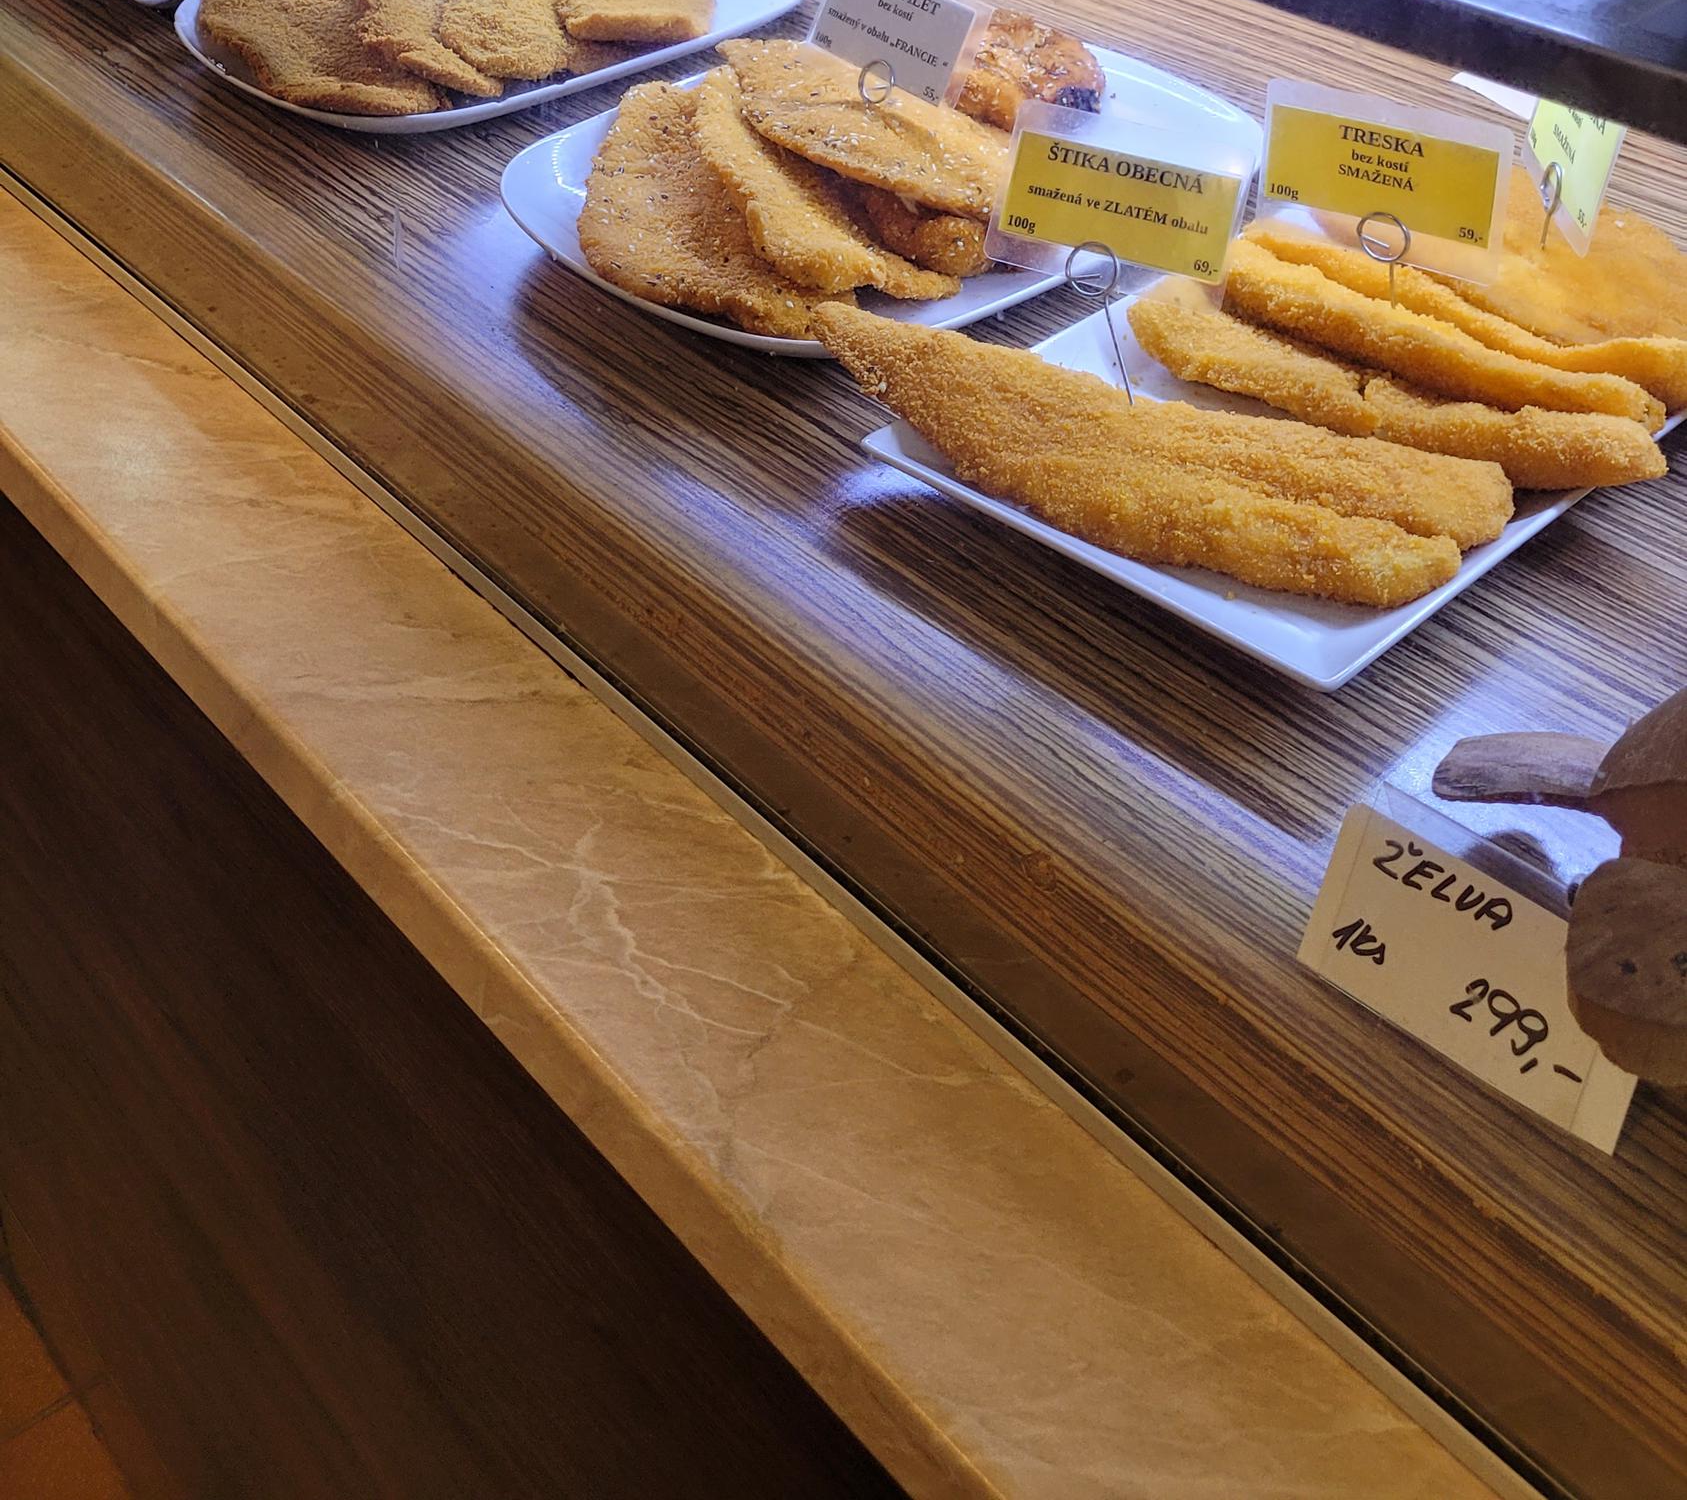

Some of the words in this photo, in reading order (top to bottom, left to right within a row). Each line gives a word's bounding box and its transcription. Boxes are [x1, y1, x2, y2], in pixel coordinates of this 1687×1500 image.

[827, 6, 861, 30] smažený
[860, 23, 867, 32] v
[866, 25, 891, 44] obalu
[892, 4, 914, 23] kostí
[922, 85, 940, 102] 55,-
[1338, 124, 1426, 158] TRESKA
[1047, 142, 1111, 174] ŠTIKA
[1115, 159, 1204, 196] OBECNÁ
[1351, 149, 1374, 165] bez
[1377, 153, 1409, 174] kostí
[1337, 163, 1415, 193] SMAŽENÁ
[1269, 182, 1299, 201] 100g
[1027, 183, 1083, 206] smažená
[1086, 197, 1101, 210] ve
[1103, 198, 1168, 226] ZLATÉM
[1171, 215, 1209, 236] obalu
[1007, 213, 1037, 235] 100g
[1458, 226, 1483, 243] 59,-
[1192, 257, 1219, 277] 69,-
[1448, 977, 1583, 1085] 299,-
